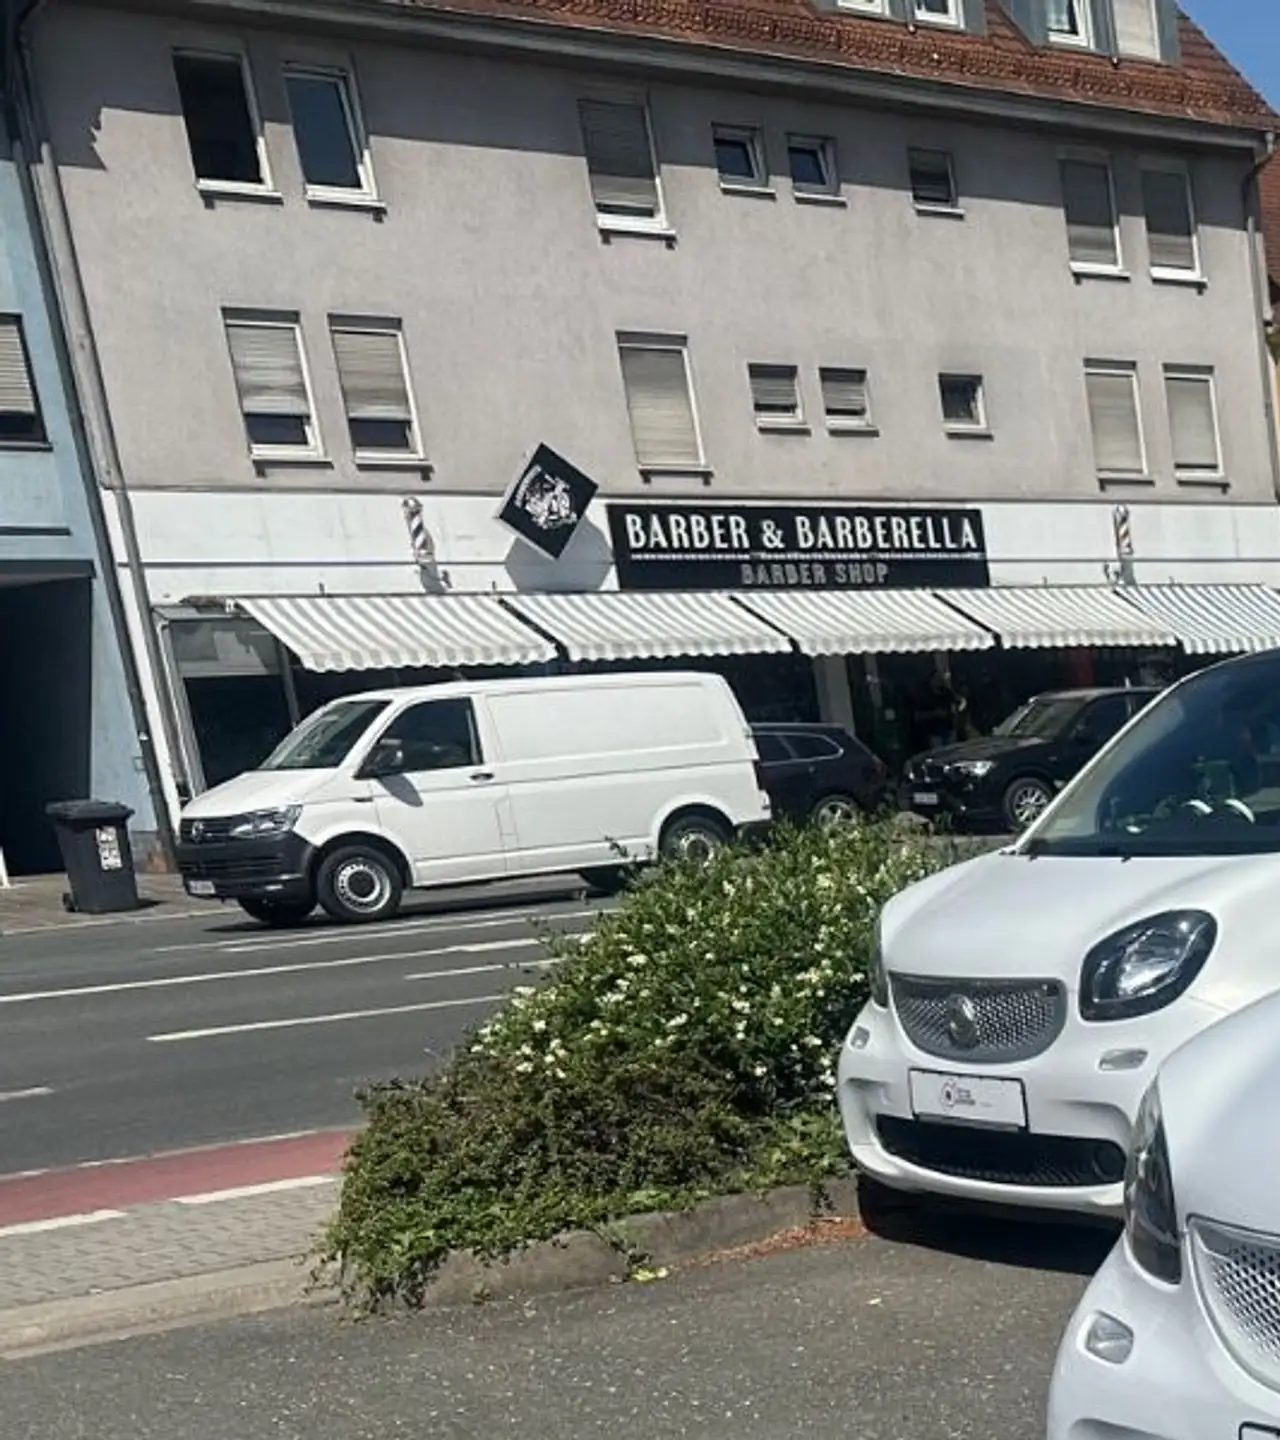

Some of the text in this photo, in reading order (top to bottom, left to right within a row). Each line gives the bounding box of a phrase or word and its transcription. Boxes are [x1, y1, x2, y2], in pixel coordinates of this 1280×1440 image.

[625, 513, 978, 549] BARBER & BARBERELLA
[741, 563, 889, 585] BARBER SHOP
